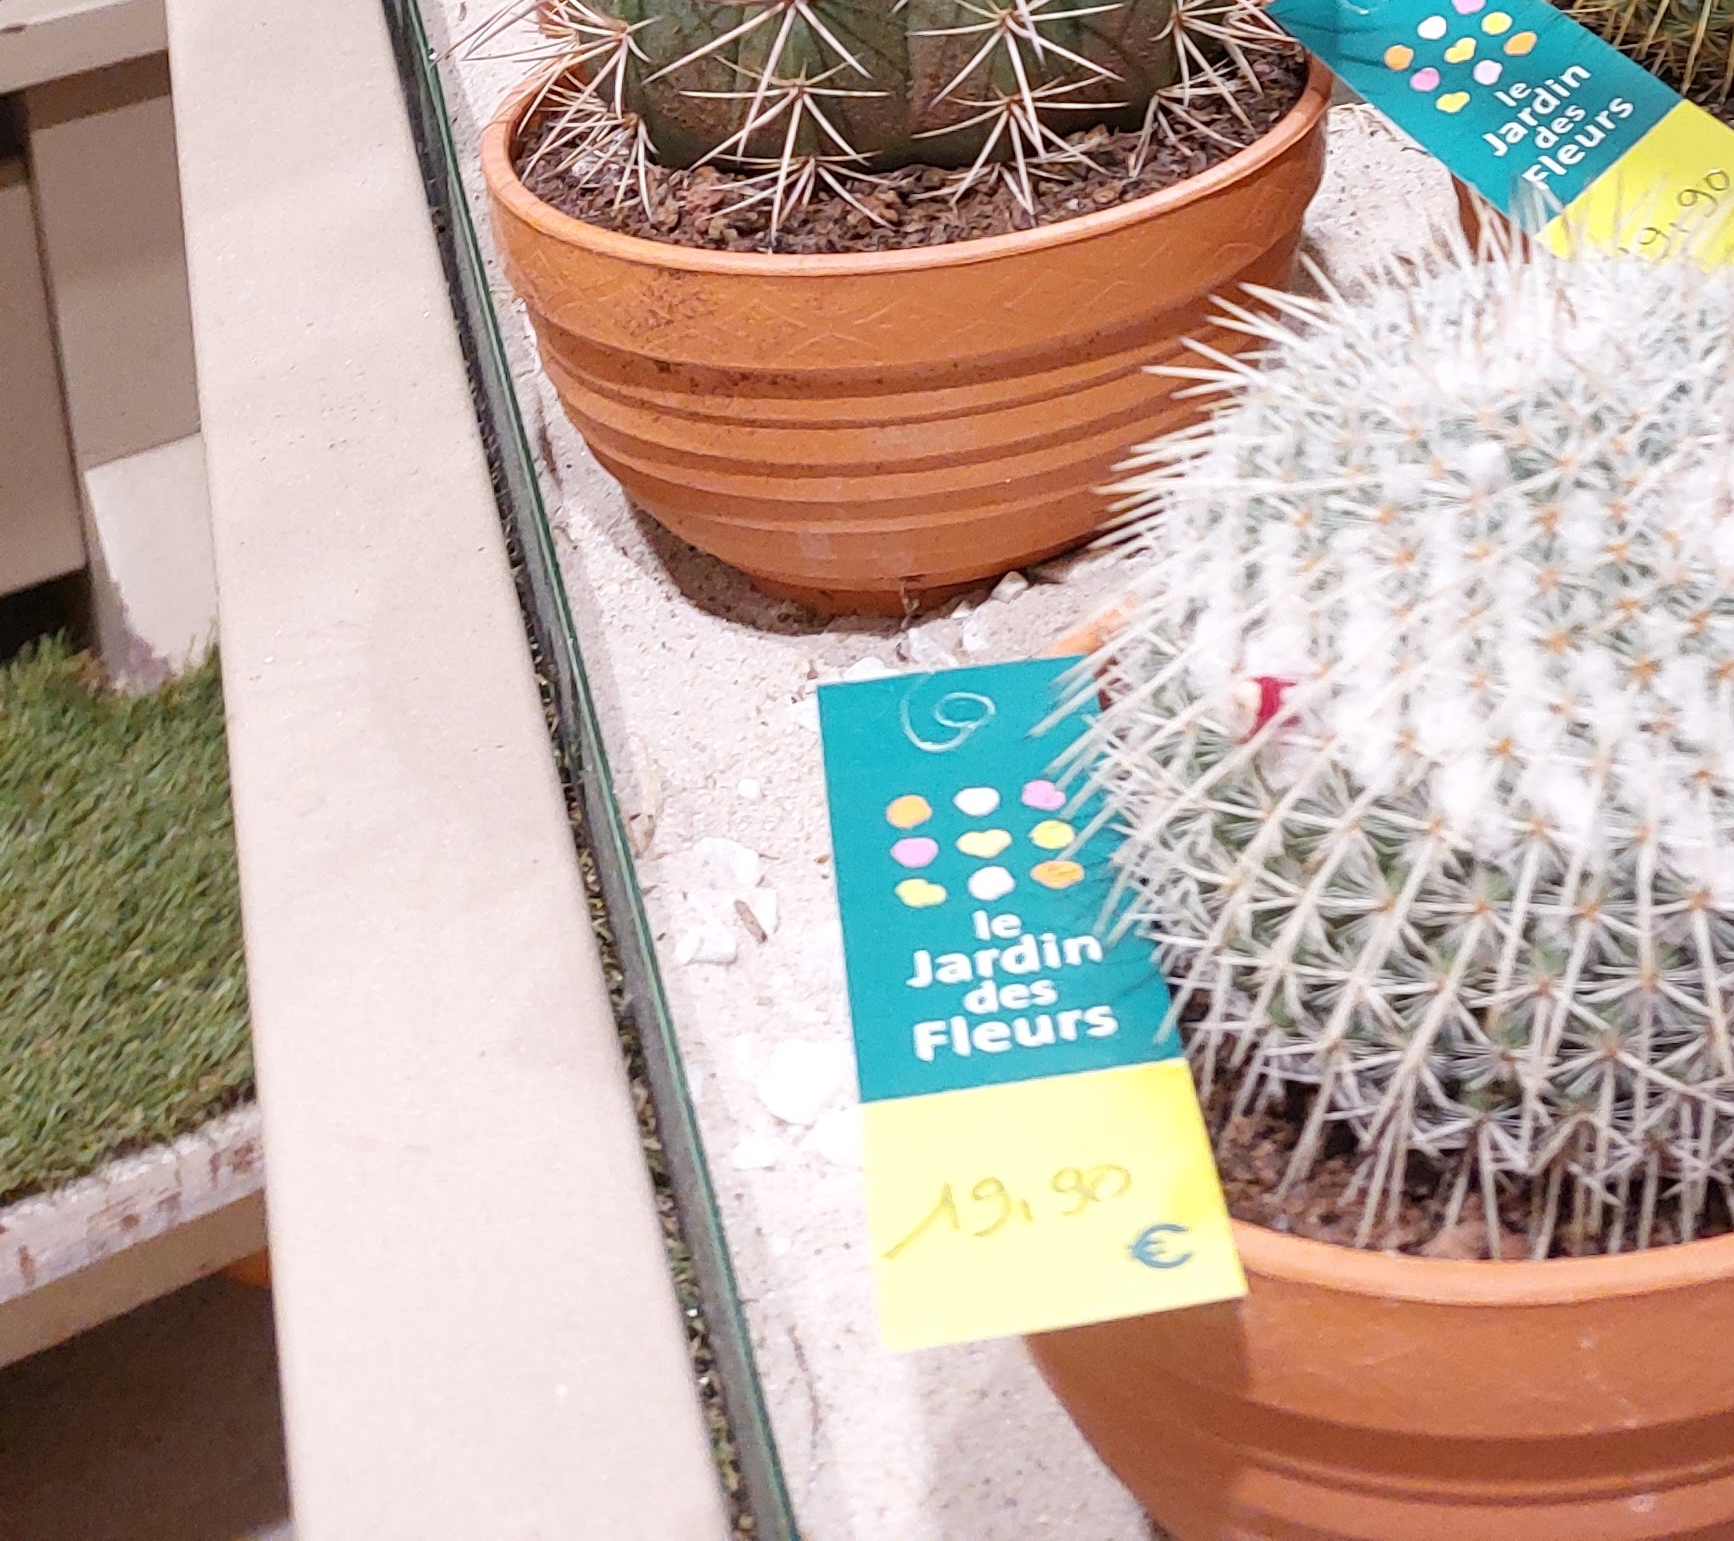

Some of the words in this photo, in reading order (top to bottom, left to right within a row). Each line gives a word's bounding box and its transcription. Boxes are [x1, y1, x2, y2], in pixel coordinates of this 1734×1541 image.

[1482, 65, 1592, 157] Jardin
[1493, 82, 1533, 108] le
[1521, 96, 1635, 191] Fleurs
[1534, 104, 1587, 149] des
[971, 909, 1022, 941] le
[905, 932, 1104, 989] Jardin
[962, 978, 1060, 1015] des
[912, 1004, 1119, 1063] Fleurs
